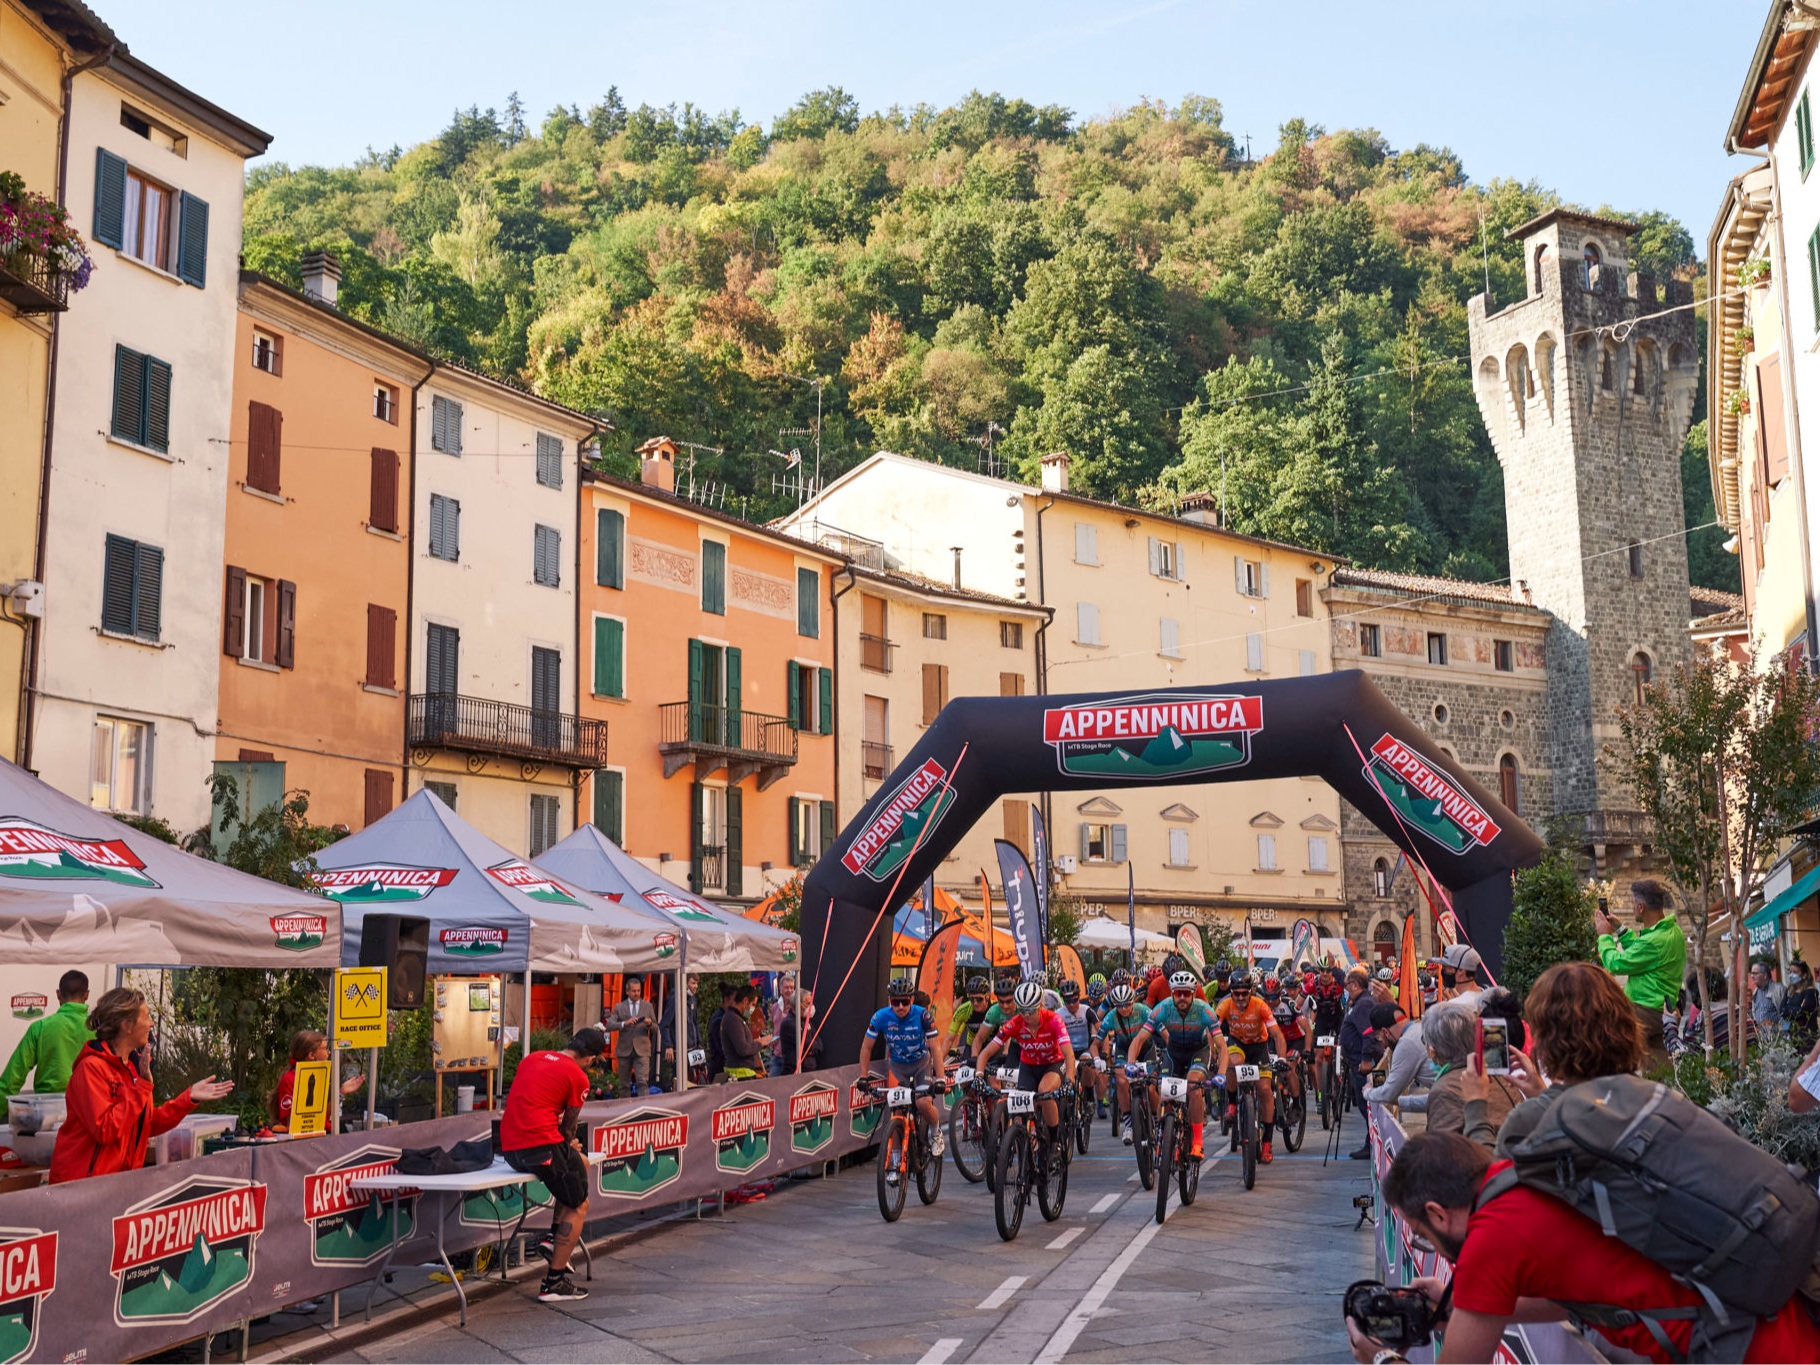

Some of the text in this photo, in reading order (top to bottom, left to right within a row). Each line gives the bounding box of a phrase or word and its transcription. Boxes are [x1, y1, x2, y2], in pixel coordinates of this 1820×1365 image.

[1058, 701, 1247, 738] APPENNINICA
[1381, 744, 1488, 837] APPENNINICA
[851, 769, 938, 867] APPENNINICA
[274, 917, 323, 932] APPENNINICA
[444, 930, 503, 942] APPENNINICA
[955, 949, 975, 963] quirt
[359, 1024, 381, 1032] OFFICE
[692, 1054, 703, 1062] 93
[1241, 1066, 1255, 1077] 95
[893, 1090, 905, 1101] 91
[1170, 1084, 1178, 1096] 8
[792, 1092, 836, 1119] APPENNINICA
[717, 1105, 771, 1137] APPENNINICA
[601, 1118, 682, 1159] APPENNINICA
[123, 1192, 256, 1264] APPENNINICA
